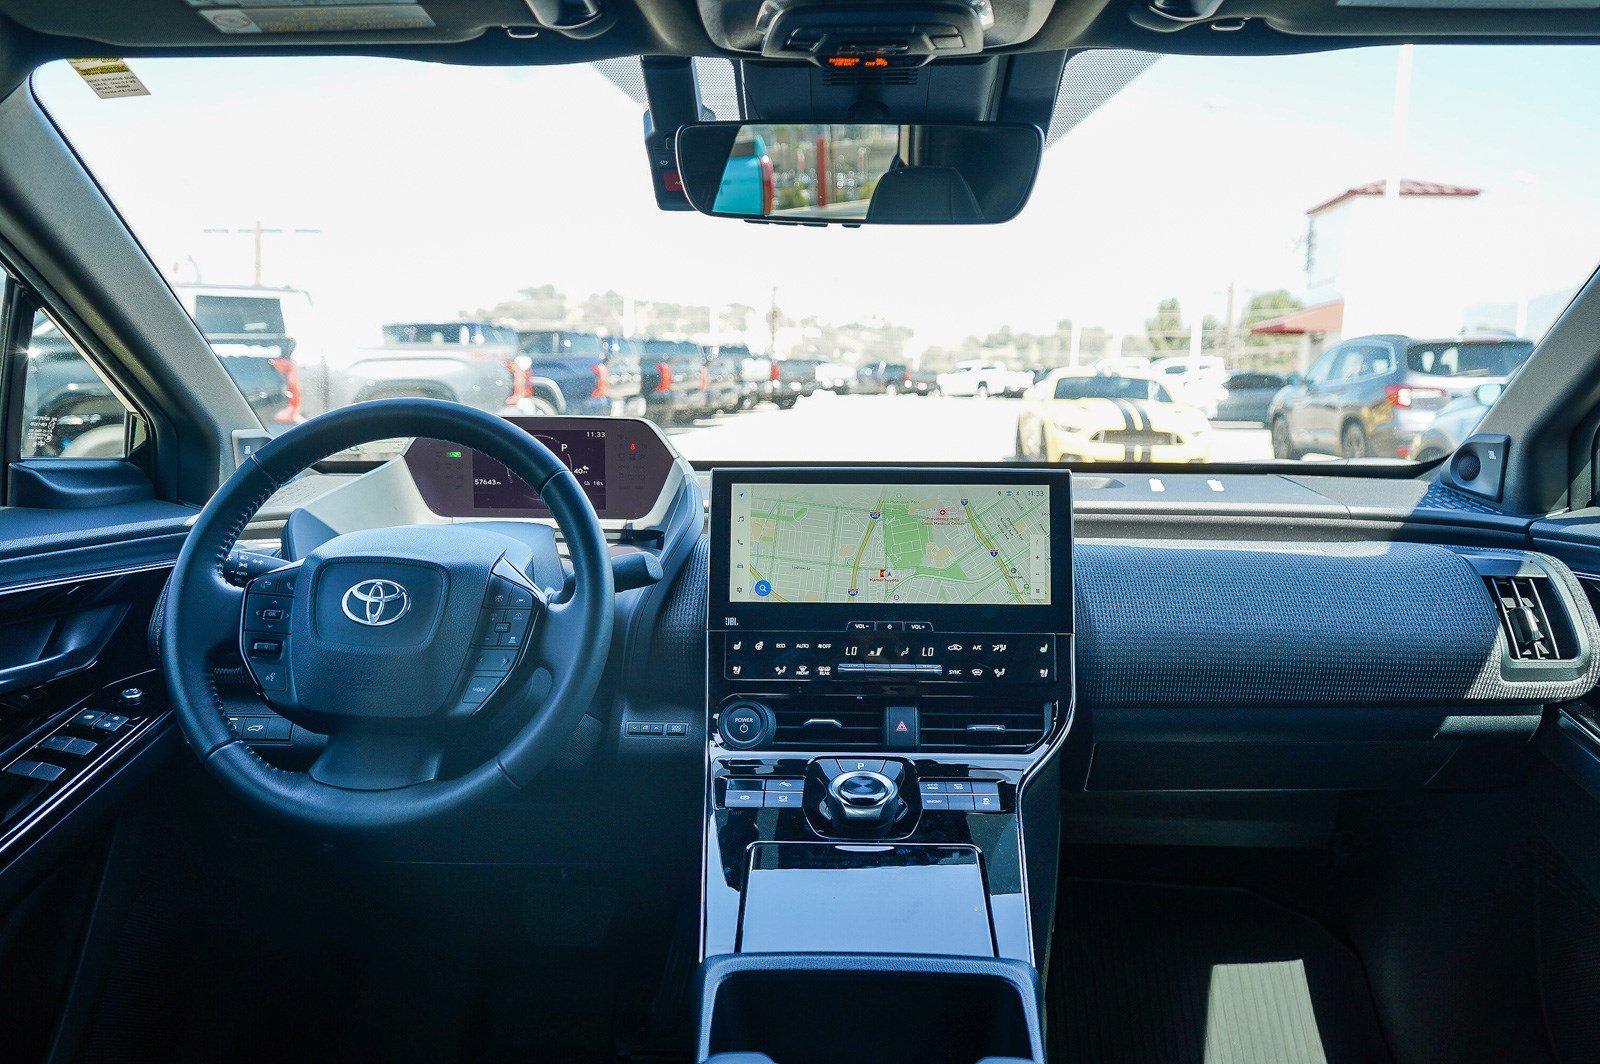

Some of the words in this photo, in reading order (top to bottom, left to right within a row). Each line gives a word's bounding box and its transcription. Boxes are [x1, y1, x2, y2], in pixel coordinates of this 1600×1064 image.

[561, 443, 568, 452] P
[724, 616, 739, 626] JBL
[845, 646, 858, 656] LO
[922, 647, 934, 657] LO
[857, 762, 865, 770] P
